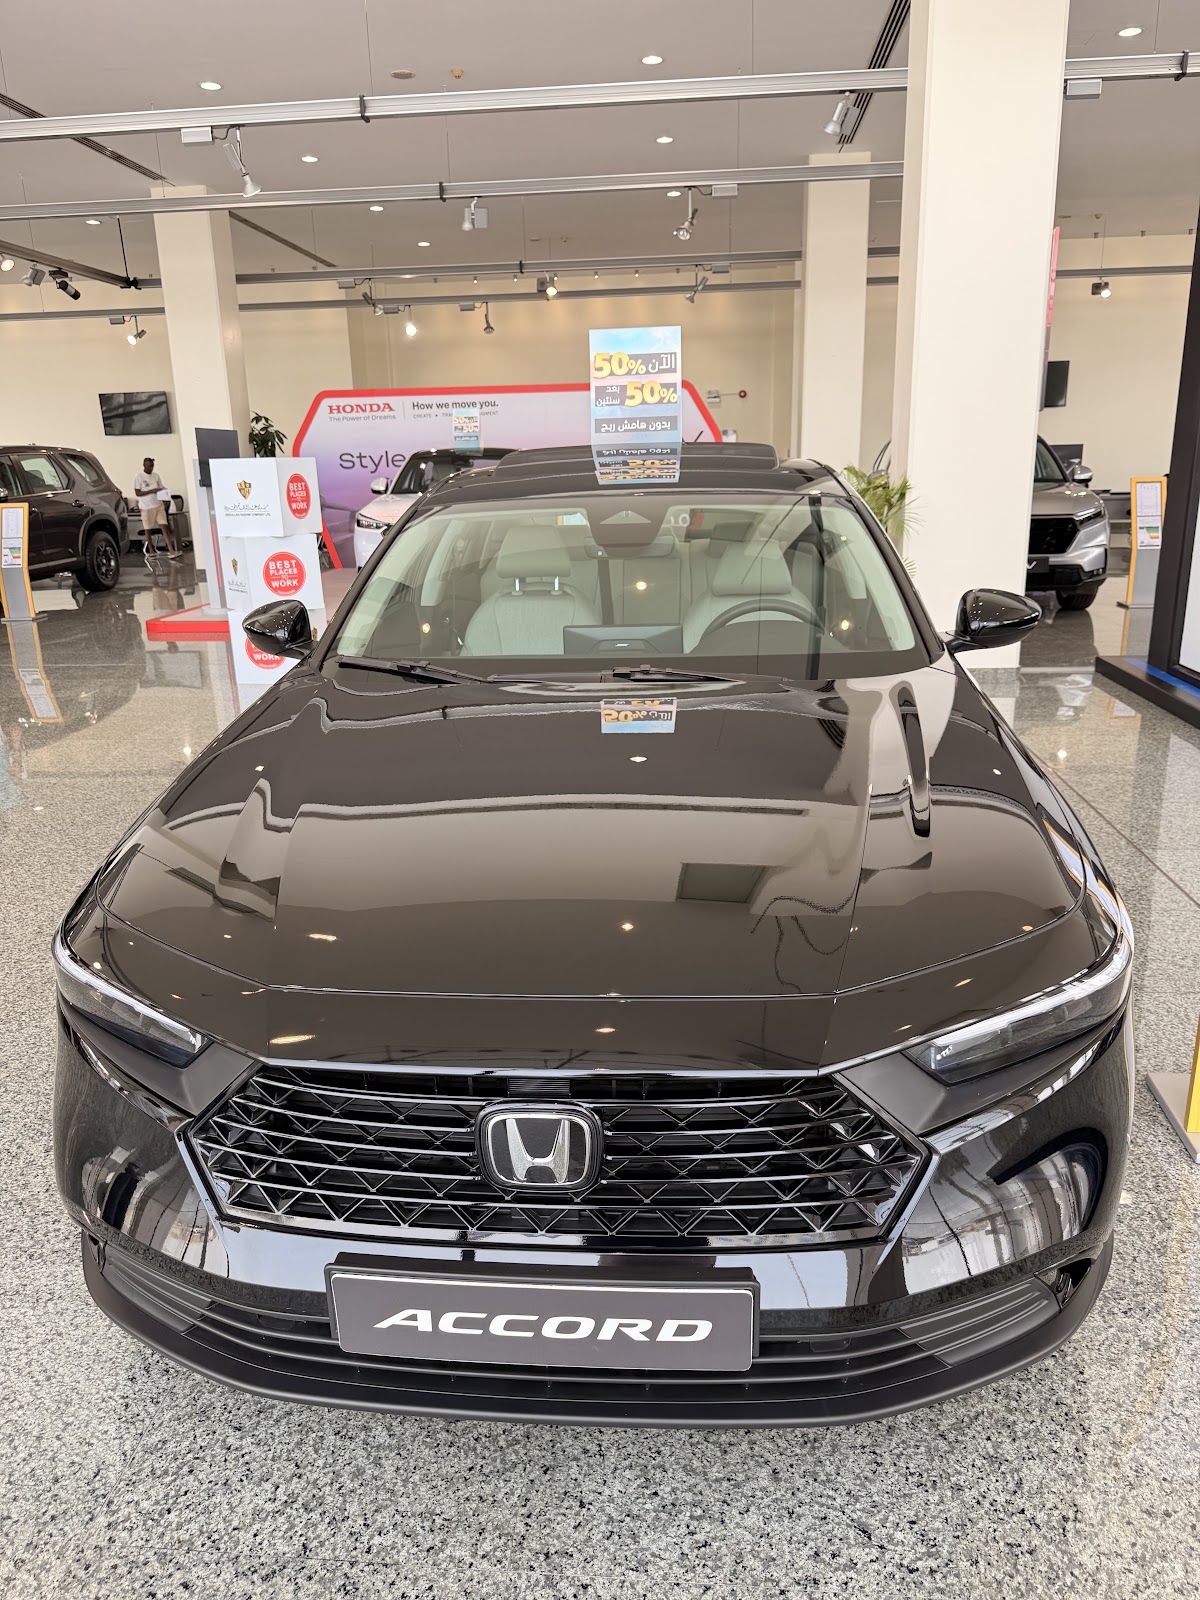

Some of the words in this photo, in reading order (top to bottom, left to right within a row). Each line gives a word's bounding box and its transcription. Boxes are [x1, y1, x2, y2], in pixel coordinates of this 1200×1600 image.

[593, 352, 646, 379] 50%
[648, 354, 675, 373] الآن
[606, 386, 620, 394] بعد
[625, 380, 677, 407] 50%
[412, 402, 433, 410] How
[479, 401, 498, 409] you.
[596, 396, 620, 406] سنتين
[328, 402, 395, 414] HONDA
[601, 423, 616, 432] ربح
[618, 420, 646, 431] هامش
[648, 421, 671, 430] بدون
[339, 450, 406, 474] Style
[269, 560, 297, 569] BEST
[271, 580, 299, 588] WORK
[372, 1308, 713, 1342] ACCORD
